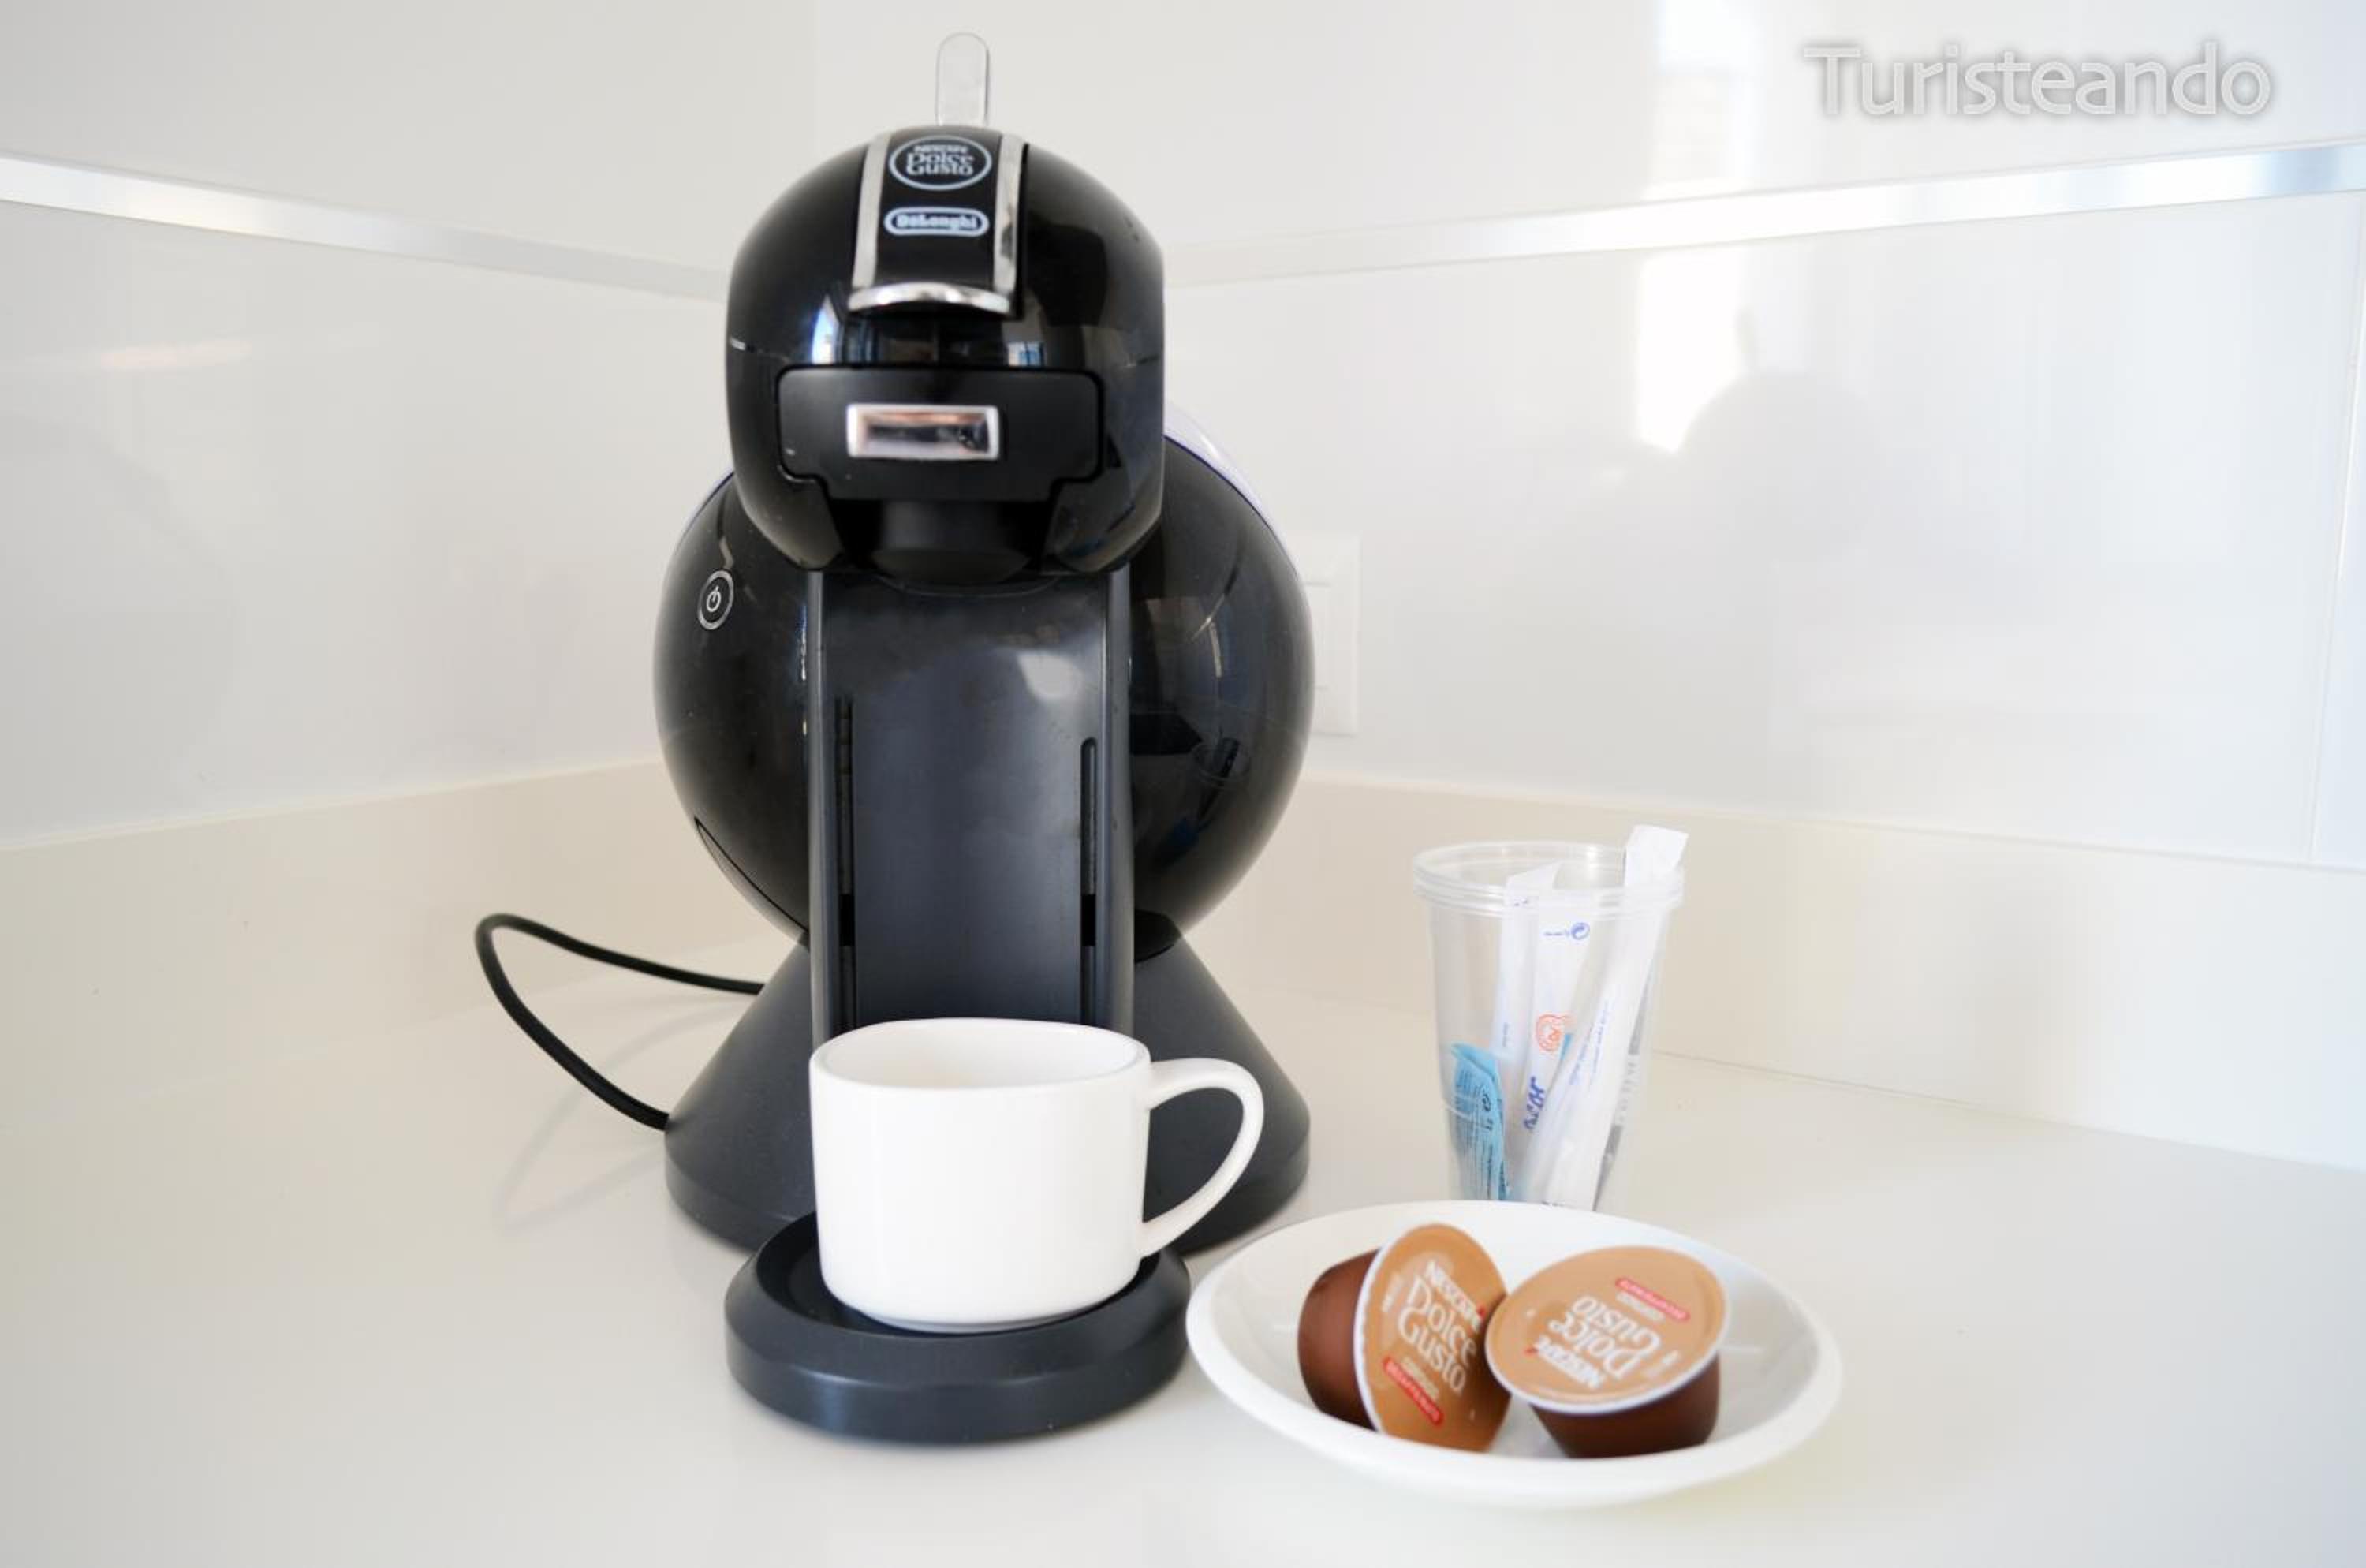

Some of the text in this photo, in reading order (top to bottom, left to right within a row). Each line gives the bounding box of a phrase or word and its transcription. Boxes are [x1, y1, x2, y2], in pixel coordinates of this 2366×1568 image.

[906, 162, 973, 176] Gusto
[907, 152, 975, 166] Dolce
[1398, 1305, 1467, 1396] Gusto
[1407, 1274, 1477, 1368] Dolce
[1548, 1311, 1641, 1379] Dolce
[1572, 1294, 1662, 1358] Gusto
